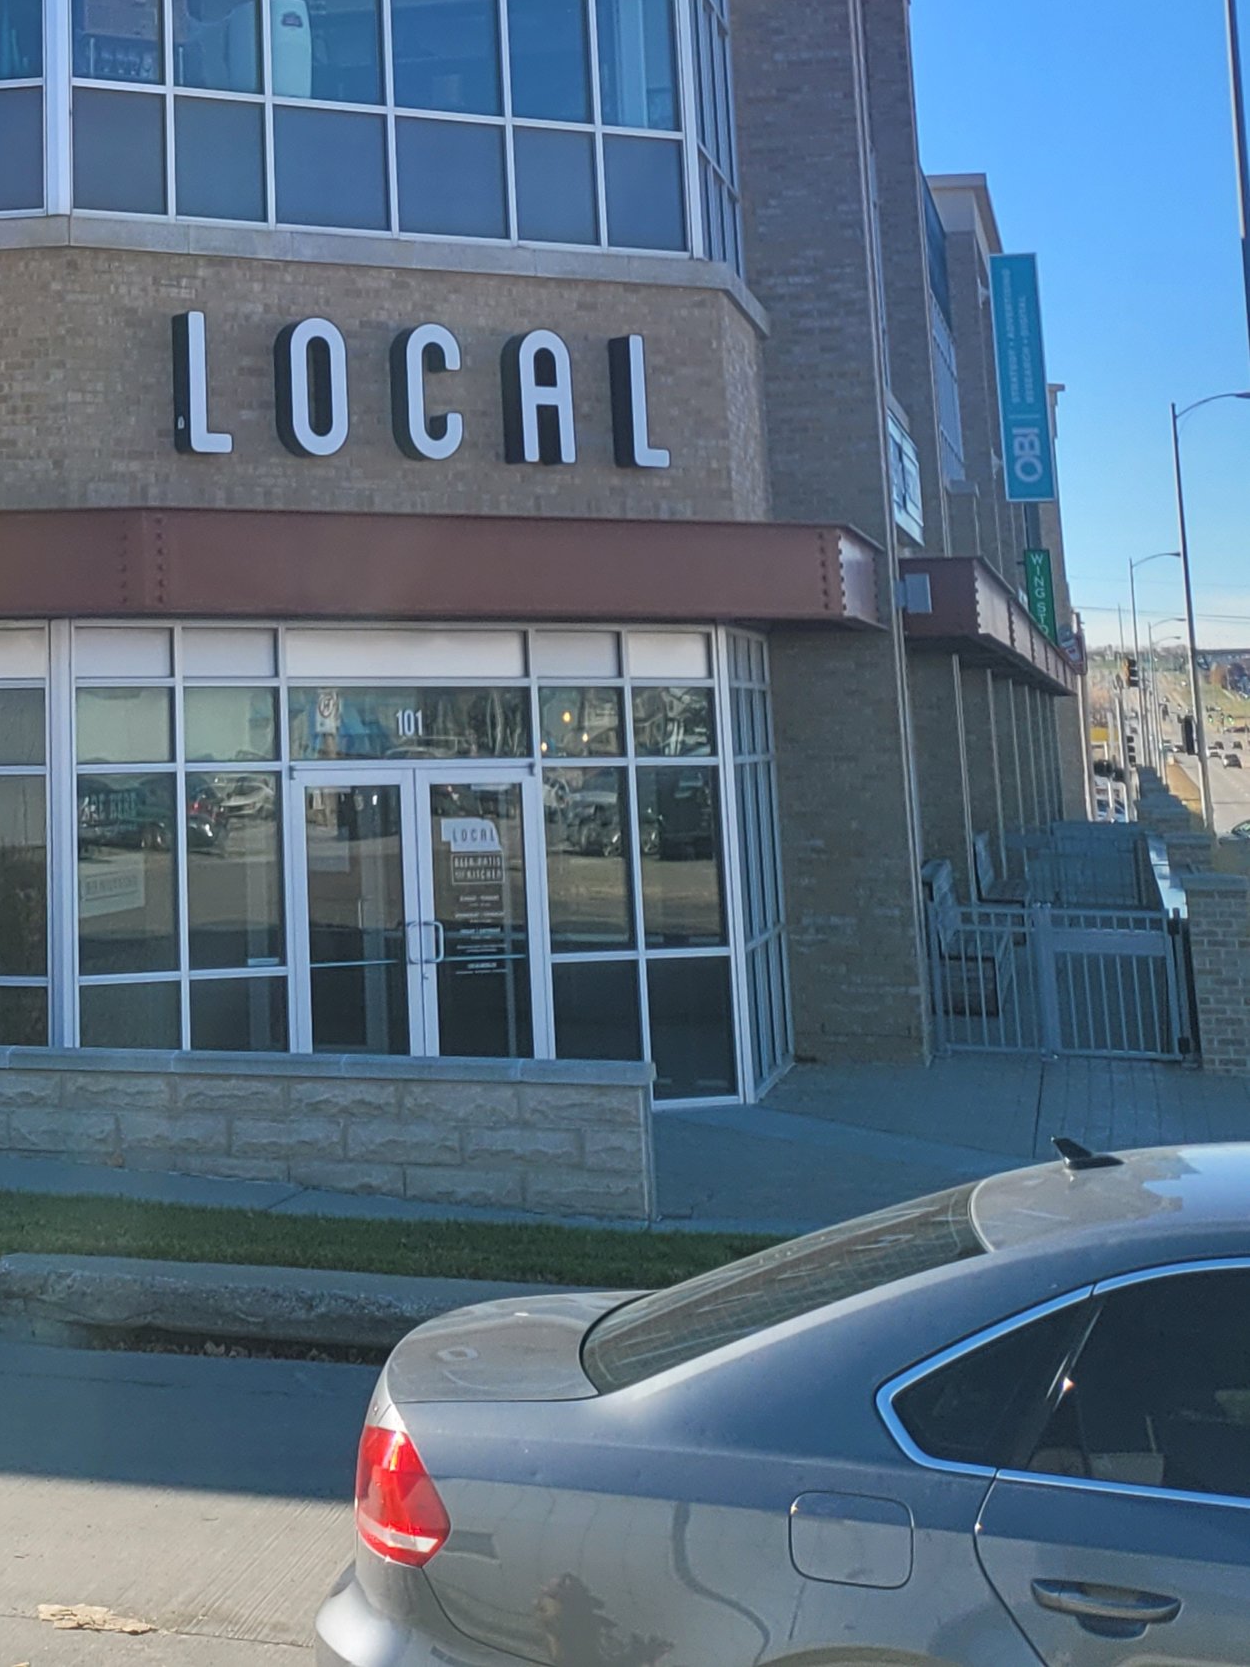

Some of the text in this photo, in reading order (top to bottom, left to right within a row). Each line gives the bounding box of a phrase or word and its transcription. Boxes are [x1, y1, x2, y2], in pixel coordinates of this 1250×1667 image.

[172, 310, 671, 469] LOCAL
[1012, 426, 1043, 483] OBI
[395, 708, 423, 737] 101
[452, 827, 496, 843] LOCAL
